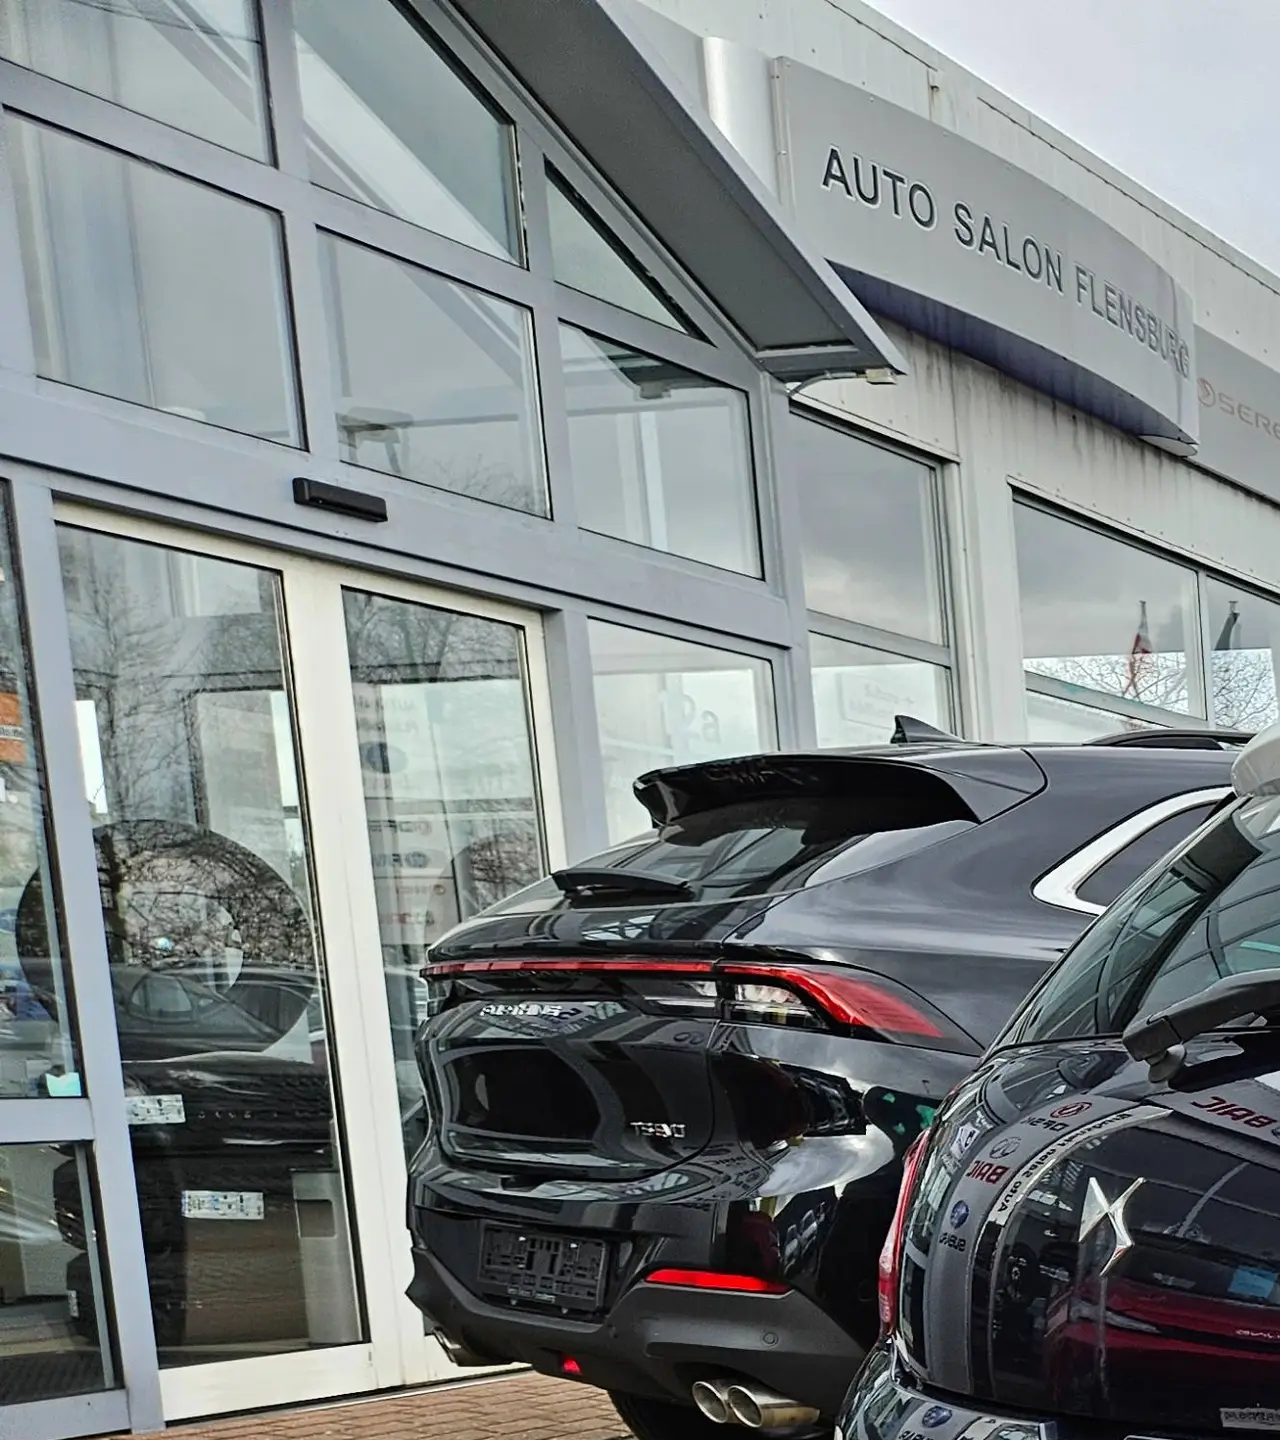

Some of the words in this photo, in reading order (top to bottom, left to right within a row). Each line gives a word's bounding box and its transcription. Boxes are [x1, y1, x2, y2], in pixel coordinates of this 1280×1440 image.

[821, 146, 936, 230] AUTO
[954, 201, 1064, 293] SALON
[1074, 263, 1190, 379] FLENSBURG
